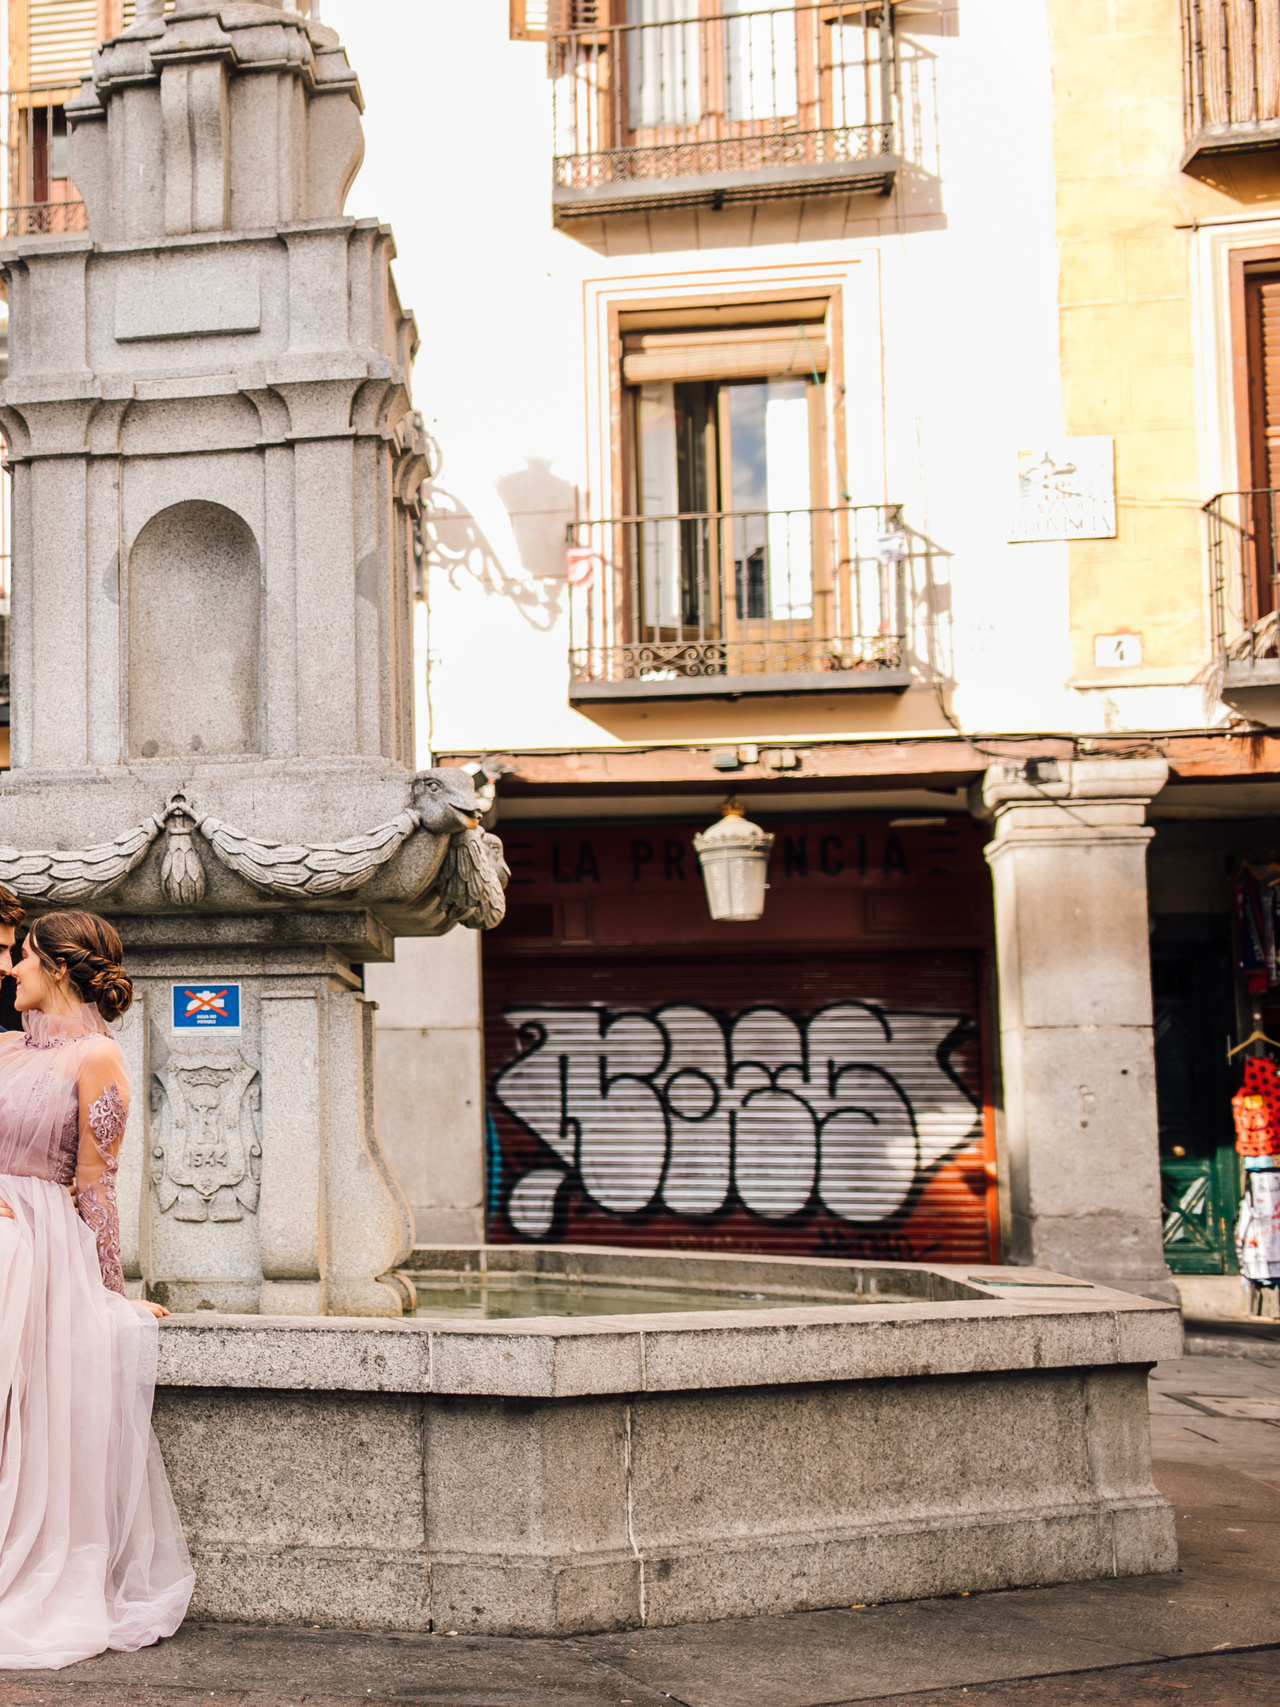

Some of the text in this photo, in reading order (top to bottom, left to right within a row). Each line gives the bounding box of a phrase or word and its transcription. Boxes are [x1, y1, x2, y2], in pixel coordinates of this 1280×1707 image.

[551, 833, 912, 884] LA PRNCIA
[185, 1151, 228, 1168] 1544
